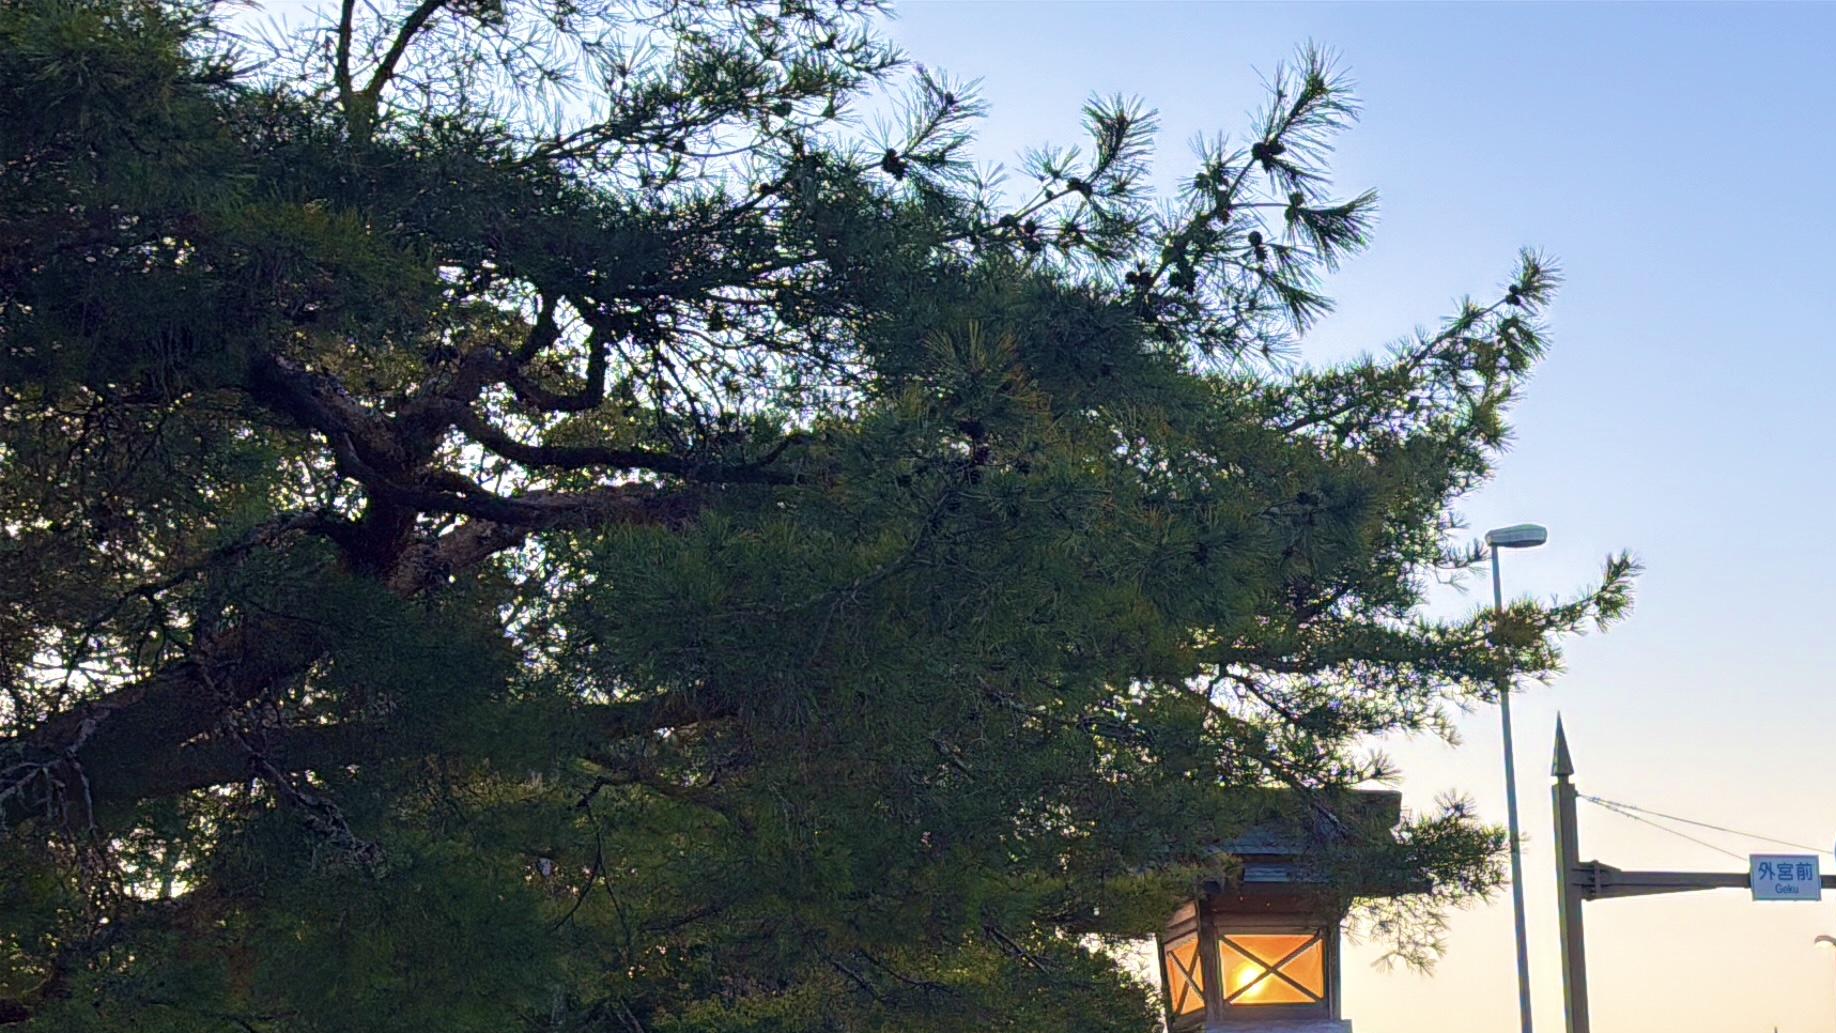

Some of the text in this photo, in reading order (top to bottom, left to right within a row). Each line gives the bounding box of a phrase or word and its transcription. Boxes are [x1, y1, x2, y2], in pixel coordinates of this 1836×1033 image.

[1758, 862, 1813, 881] 外宮前
[1775, 883, 1799, 894] Geku
